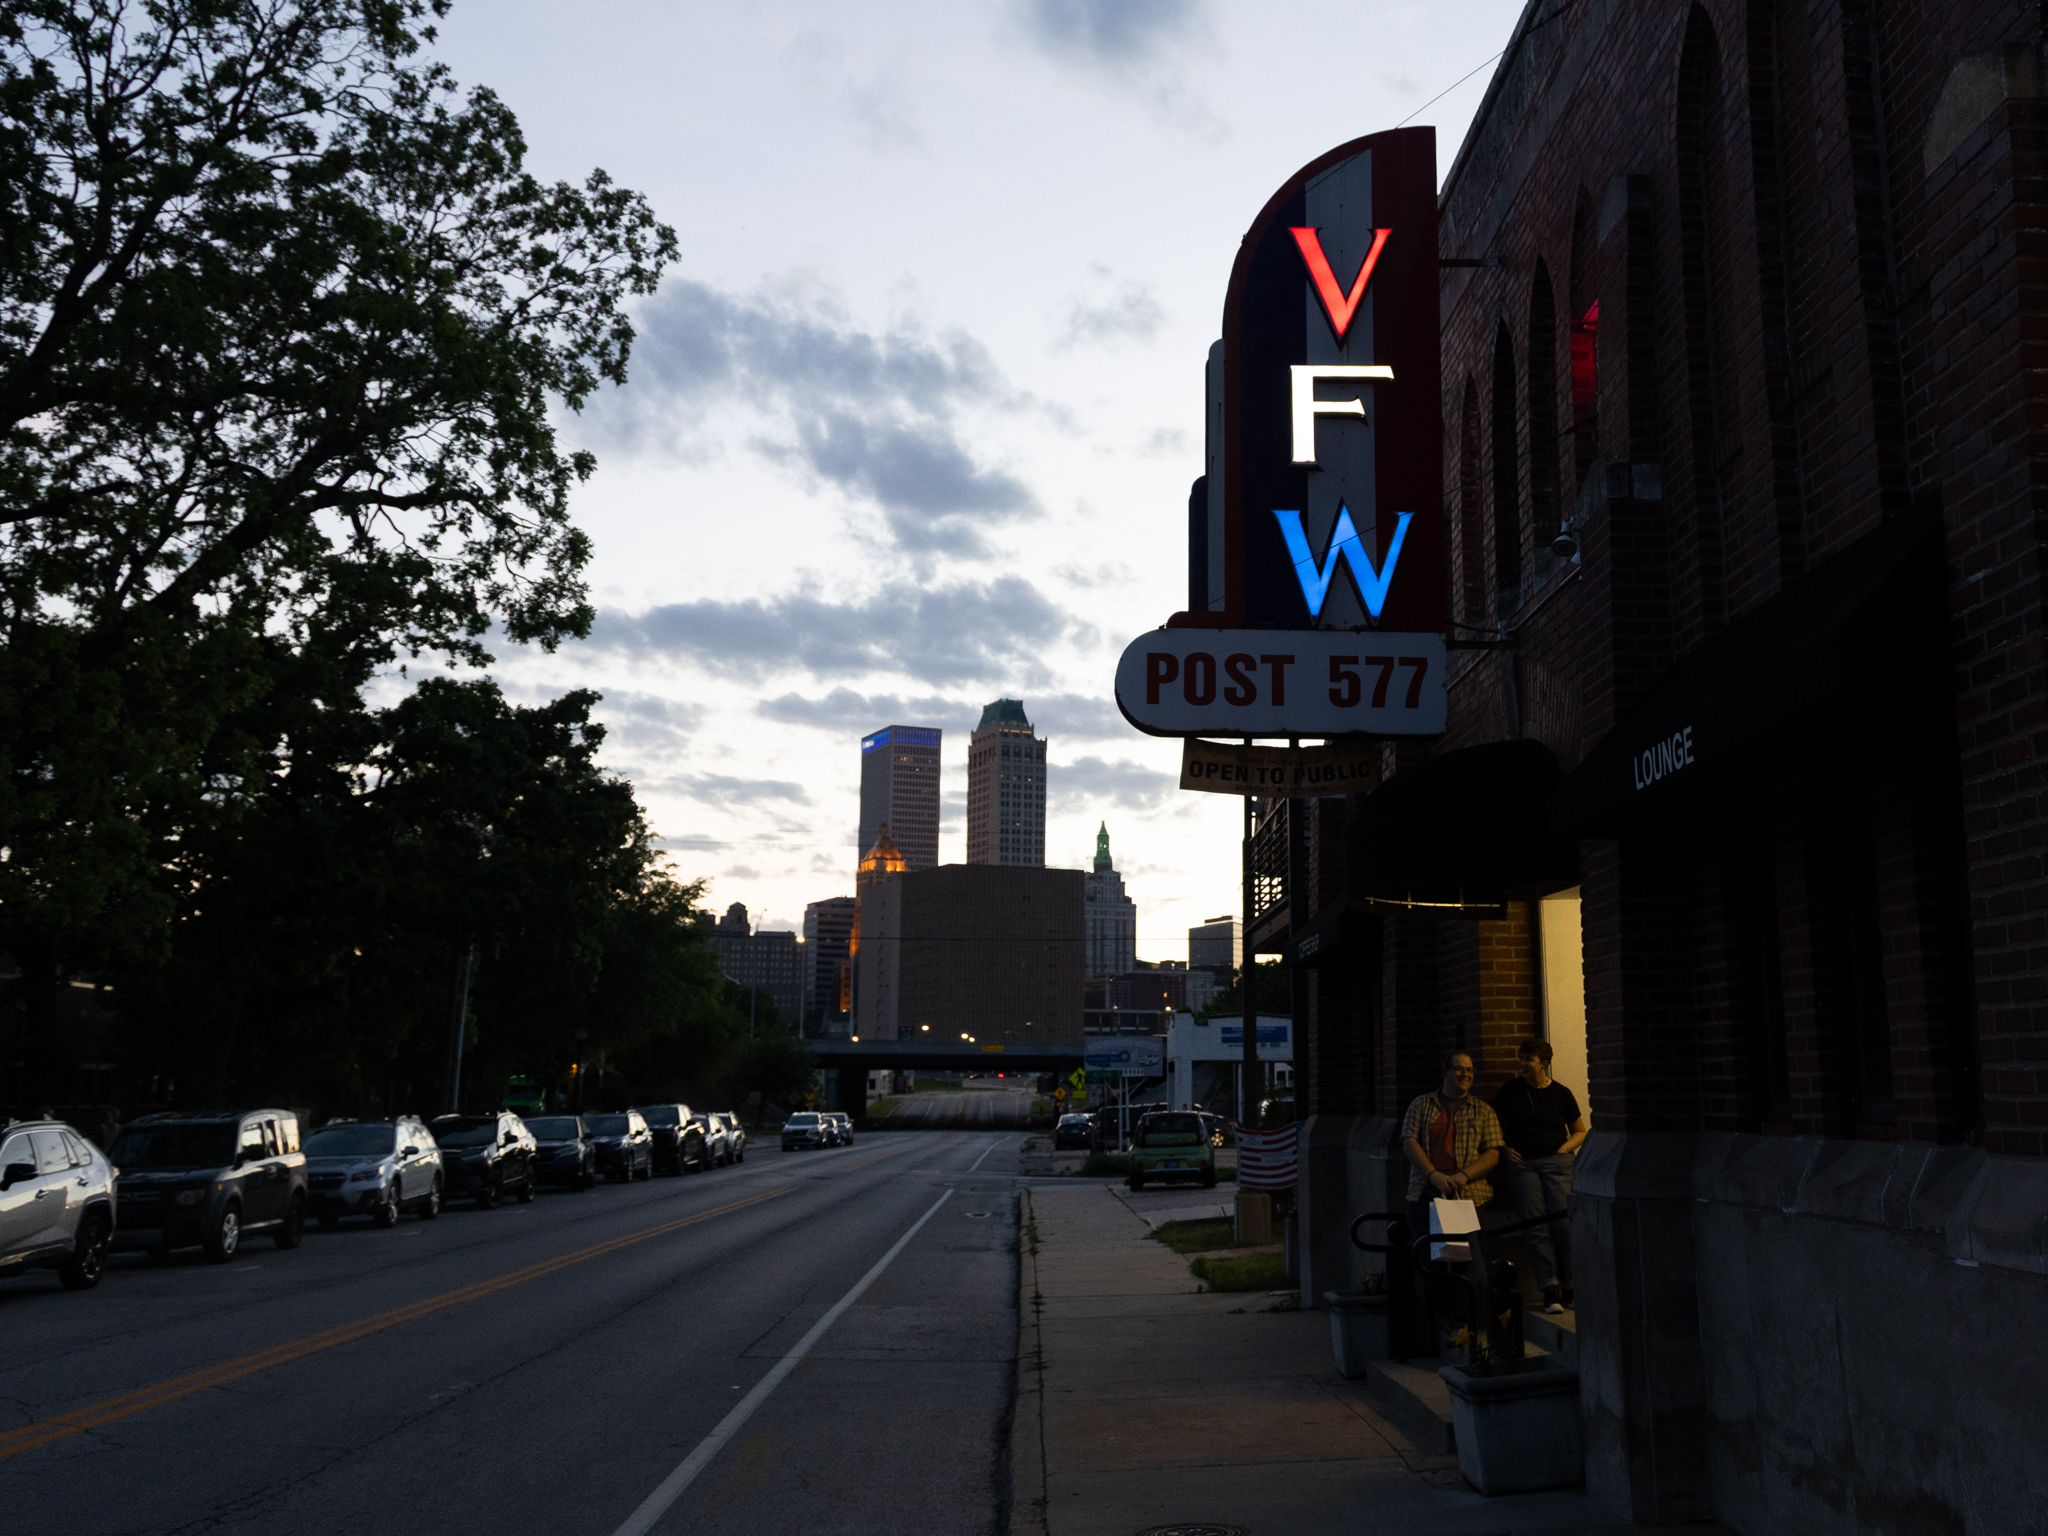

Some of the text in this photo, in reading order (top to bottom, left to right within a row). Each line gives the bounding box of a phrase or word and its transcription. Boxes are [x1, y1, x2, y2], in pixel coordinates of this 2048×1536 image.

[1146, 652, 1428, 708] POST 577
[1189, 760, 1371, 784] OPEN TO PUBLIC
[1634, 725, 1694, 790] LOUNGE
[1235, 784, 1327, 793] SUPPORT VETERANS
